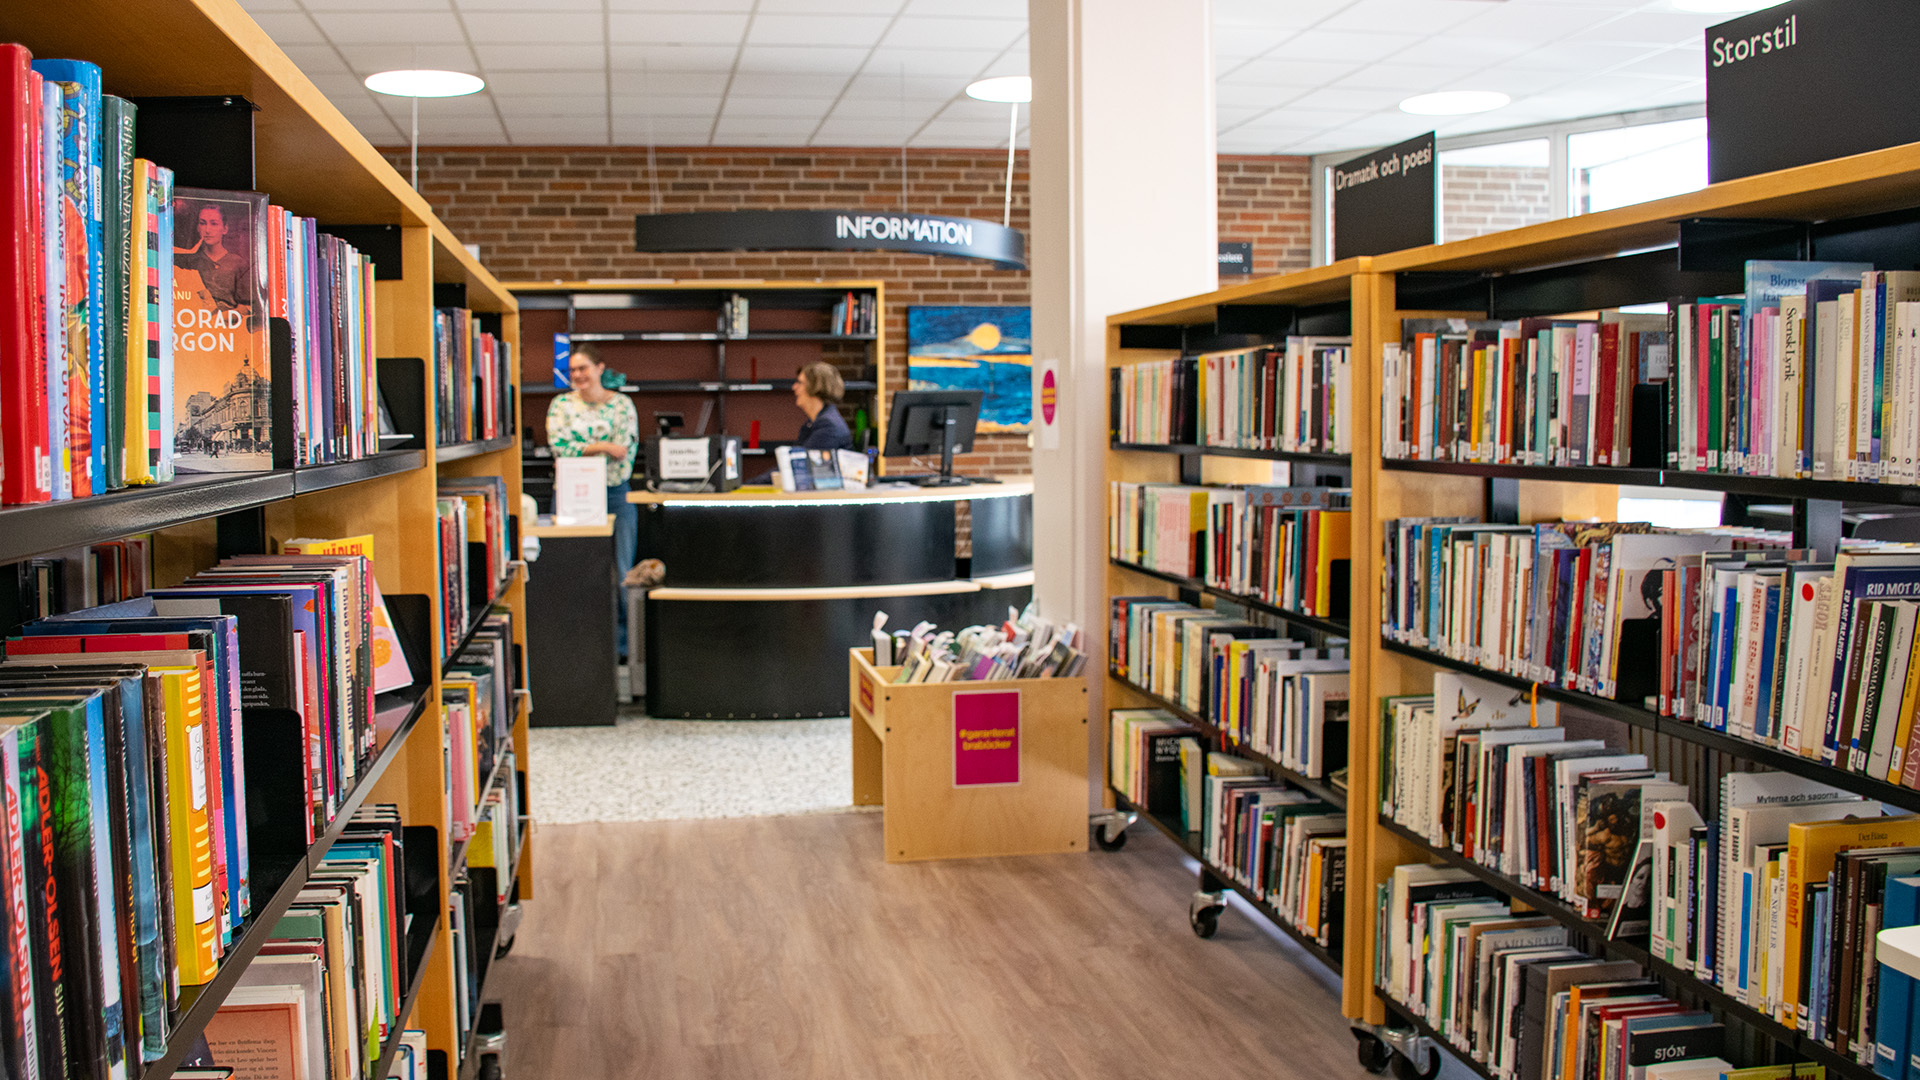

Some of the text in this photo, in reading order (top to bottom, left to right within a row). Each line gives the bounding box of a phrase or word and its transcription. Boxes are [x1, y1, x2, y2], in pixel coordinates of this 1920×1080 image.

[1712, 14, 1797, 67] Storstil
[77, 103, 89, 218] ADEBAYO
[1336, 142, 1432, 191] Dramatik och poesi
[56, 106, 65, 261] TAYLOR ADAMS
[836, 215, 972, 246] INFORMATION
[59, 283, 67, 361] INGEN
[173, 308, 242, 329] ORAD
[1784, 308, 1797, 350] Svensk
[1782, 350, 1796, 383] Lyrik
[1815, 582, 1829, 630] SAGOR
[1840, 603, 1849, 620] MOT
[1843, 589, 1851, 602] RID
[1867, 583, 1884, 596] RID
[1886, 582, 1912, 596] MOT
[1862, 621, 1886, 733] GESTA ROMANORUM
[1757, 795, 1788, 804] Myterna
[1790, 793, 1806, 802] och
[36, 765, 63, 983] ADLER-OLSEN
[5, 783, 32, 1012] ADLER-OLSEN
[130, 912, 139, 964] havet
[54, 983, 66, 1016] SJU
[1655, 1045, 1686, 1061] SJÓN
